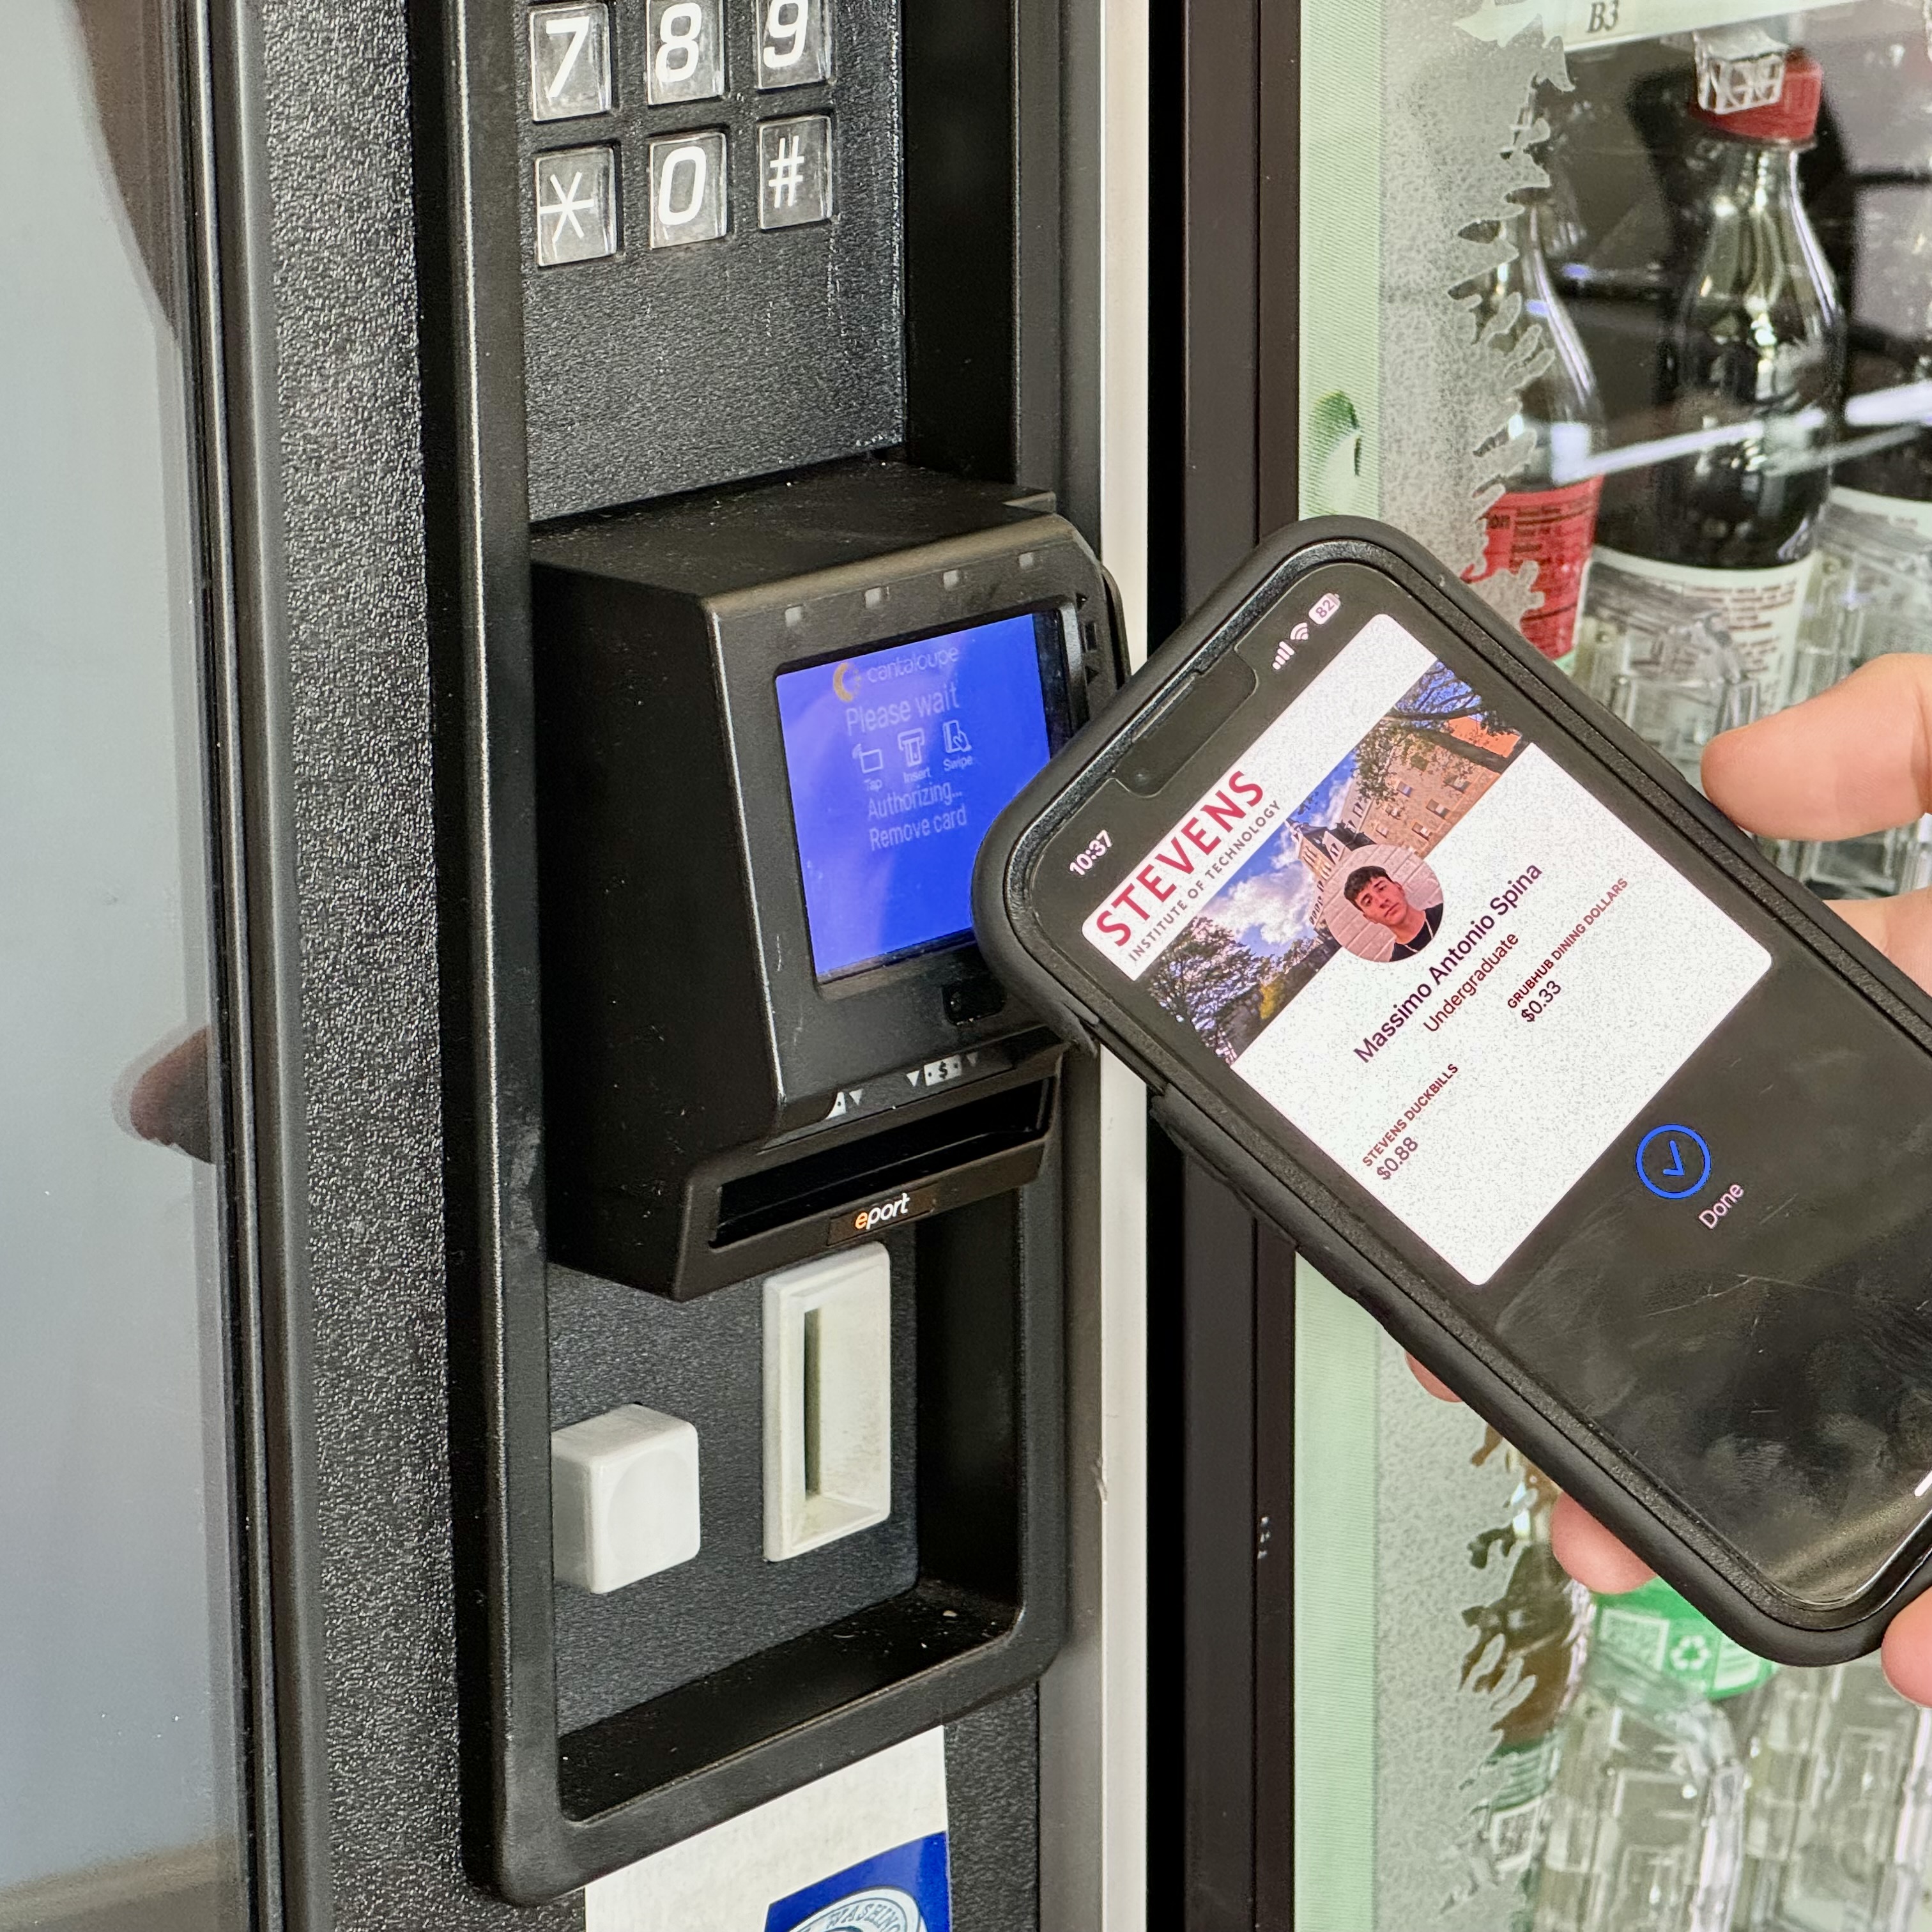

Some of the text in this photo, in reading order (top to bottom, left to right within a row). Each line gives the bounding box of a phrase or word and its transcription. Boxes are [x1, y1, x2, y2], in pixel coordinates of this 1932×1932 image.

[1586, 0, 1618, 33] B3
[546, 0, 809, 100] 7 8 9
[657, 146, 707, 226] 0
[769, 136, 804, 209] #
[1316, 599, 1335, 618] 82
[867, 648, 958, 683] cantaloupe
[845, 683, 960, 736] Please wait
[864, 779, 882, 792] Tap
[903, 767, 931, 783] Insert
[944, 755, 972, 772] Swipe
[867, 783, 962, 820] Authorizing...
[870, 804, 967, 851] Remove card
[1070, 830, 1113, 875] 10:37
[1096, 770, 1264, 947] STEVENS
[1129, 800, 1281, 962] INSTITUTE OF TECHNOLOGY
[1353, 864, 1542, 1063] Massimo Antonio Spina
[1507, 878, 1628, 1008] GRUBHUB DINING DOLLARS
[1423, 933, 1519, 1032] Undergraduate
[1521, 980, 1561, 1022] $0.33
[1362, 1064, 1458, 1167] STEVENS DUCKBILLS
[1377, 1137, 1418, 1180] $0.88
[855, 1193, 910, 1230] eport
[1699, 1184, 1744, 1229] Done
